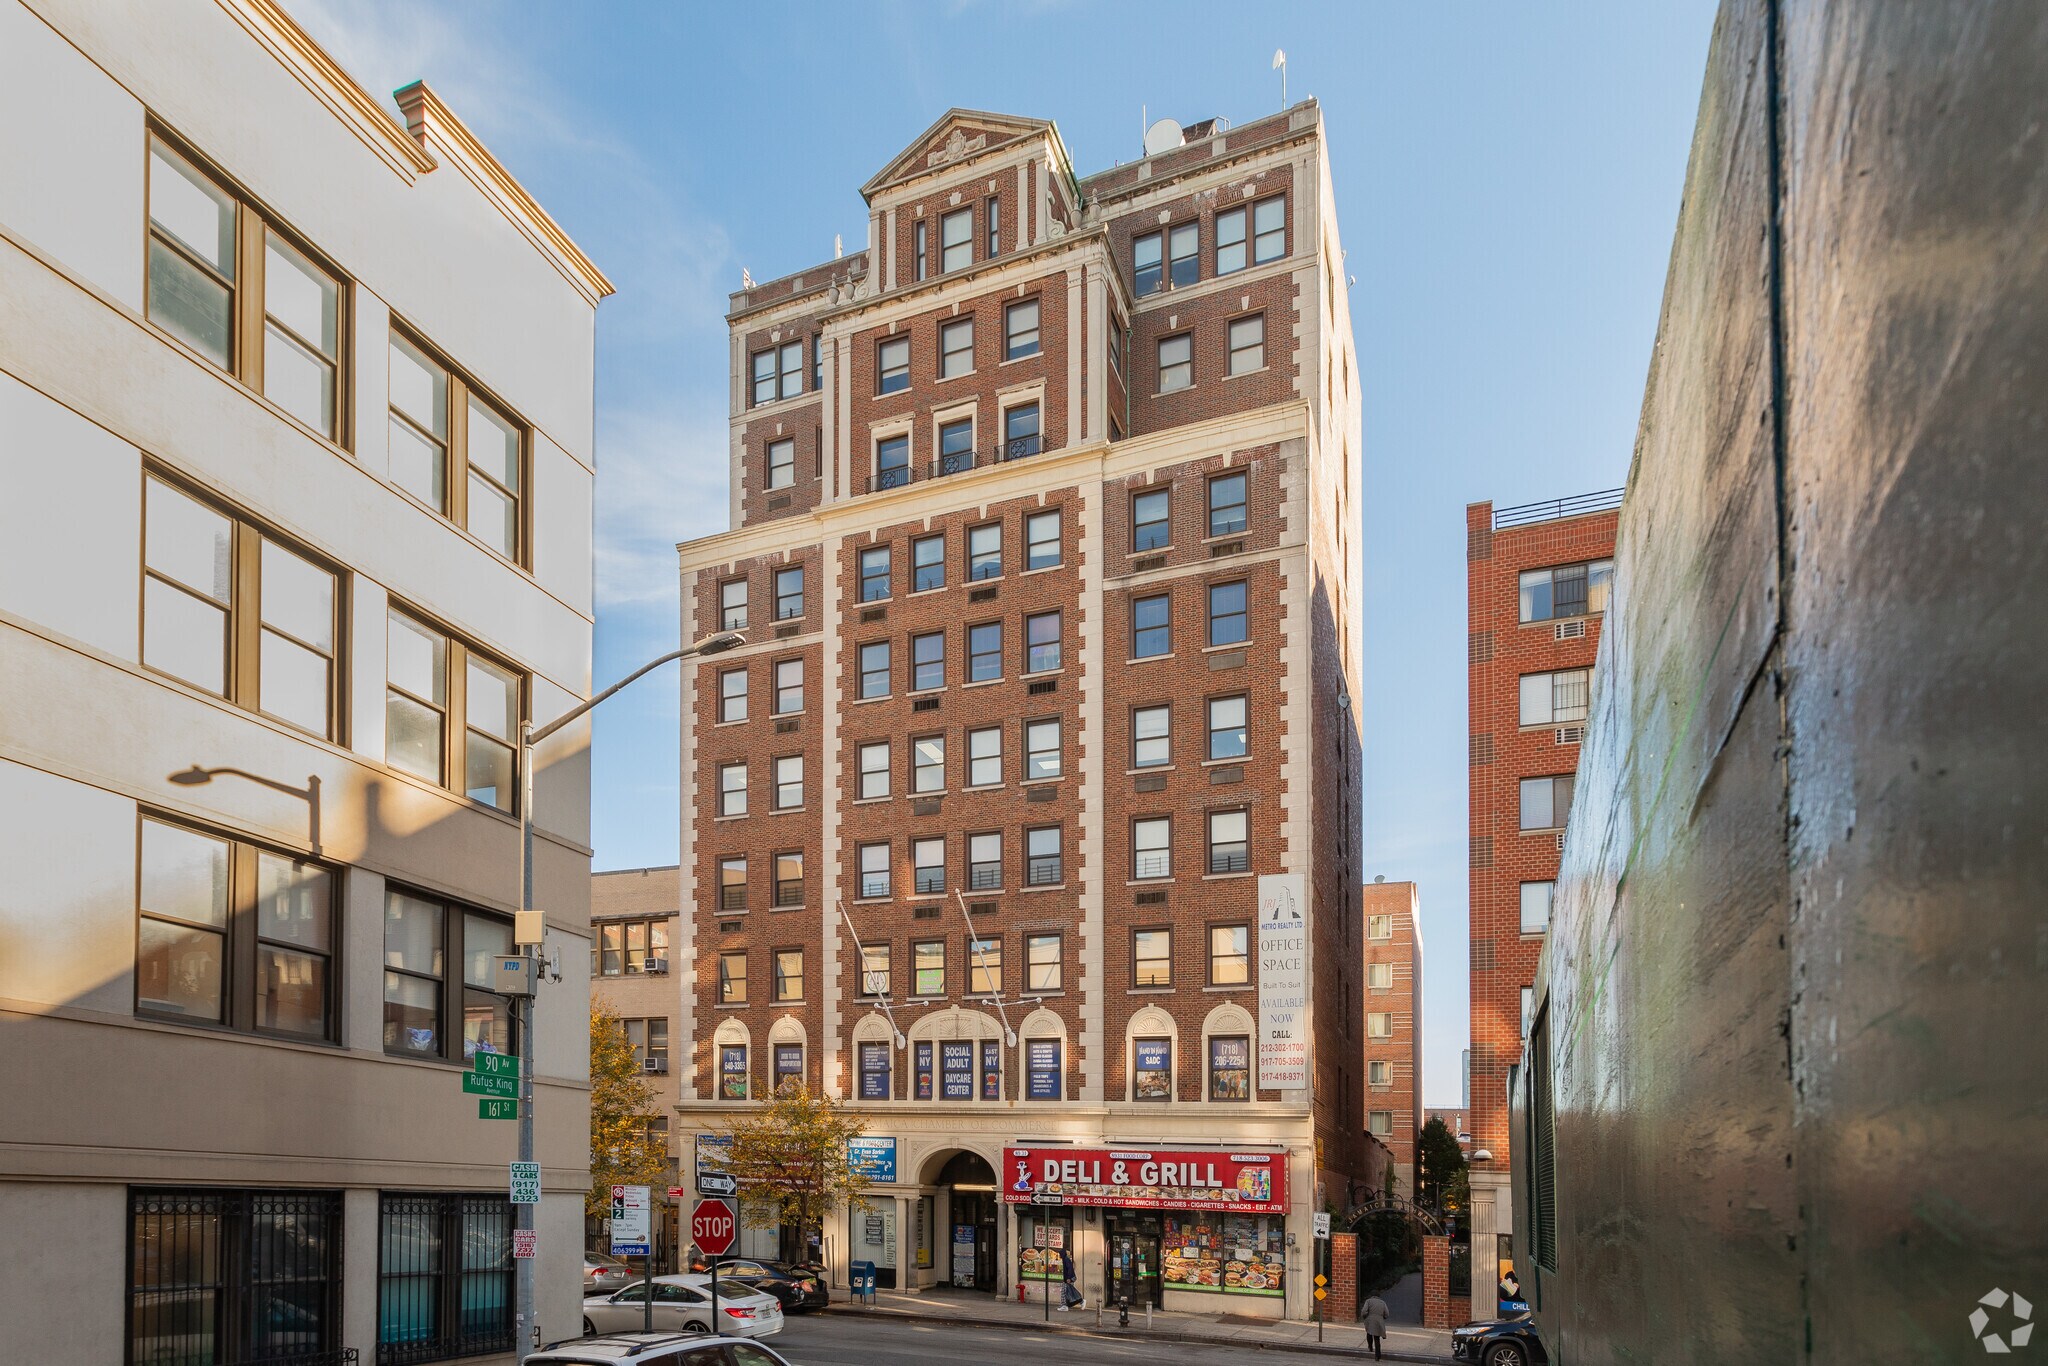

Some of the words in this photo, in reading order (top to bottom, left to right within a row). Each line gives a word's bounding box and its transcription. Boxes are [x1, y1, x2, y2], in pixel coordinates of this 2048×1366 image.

[1261, 922, 1276, 930] METRO
[1261, 938, 1303, 952] OFFICE
[504, 961, 520, 971] NYPD
[1263, 958, 1301, 971] SPACE
[1261, 998, 1304, 1009] AVAILABLE
[1270, 1014, 1295, 1024] NOW
[1271, 1030, 1293, 1039] CALL:
[945, 1046, 971, 1057] SOCIAL
[1221, 1043, 1238, 1055] (718)
[1261, 1043, 1304, 1052] 212-302-1700
[729, 1051, 741, 1061] (718)
[919, 1056, 931, 1066] NY
[985, 1056, 998, 1066] NY
[1145, 1056, 1161, 1065] SADC
[1214, 1056, 1245, 1066] 206-2254
[485, 1055, 498, 1072] 90
[502, 1058, 510, 1068] Av
[724, 1061, 745, 1070] 640-3355
[946, 1058, 969, 1068] ADULT
[1261, 1058, 1304, 1066] 917-705-3509
[945, 1073, 971, 1083] DAYCARE
[1261, 1072, 1304, 1081] 917-418-9371
[470, 1074, 494, 1087] Rufus
[496, 1078, 513, 1093] King
[947, 1085, 970, 1095] CENTER
[488, 1102, 500, 1117] 161
[503, 1102, 510, 1111] St
[912, 1119, 964, 1130] CHAMBER
[970, 1120, 986, 1130] OF
[991, 1120, 1057, 1131] COMMERCE
[512, 1164, 538, 1172] CASH
[1044, 1160, 1100, 1183] DELI
[1111, 1161, 1130, 1184] &
[1140, 1162, 1222, 1187] GRILL
[702, 1179, 715, 1187] ONE
[720, 1181, 732, 1189] WAY
[615, 1210, 622, 1219] 2
[1348, 1202, 1386, 1224] JAMAICA
[694, 1217, 732, 1237] STOP
